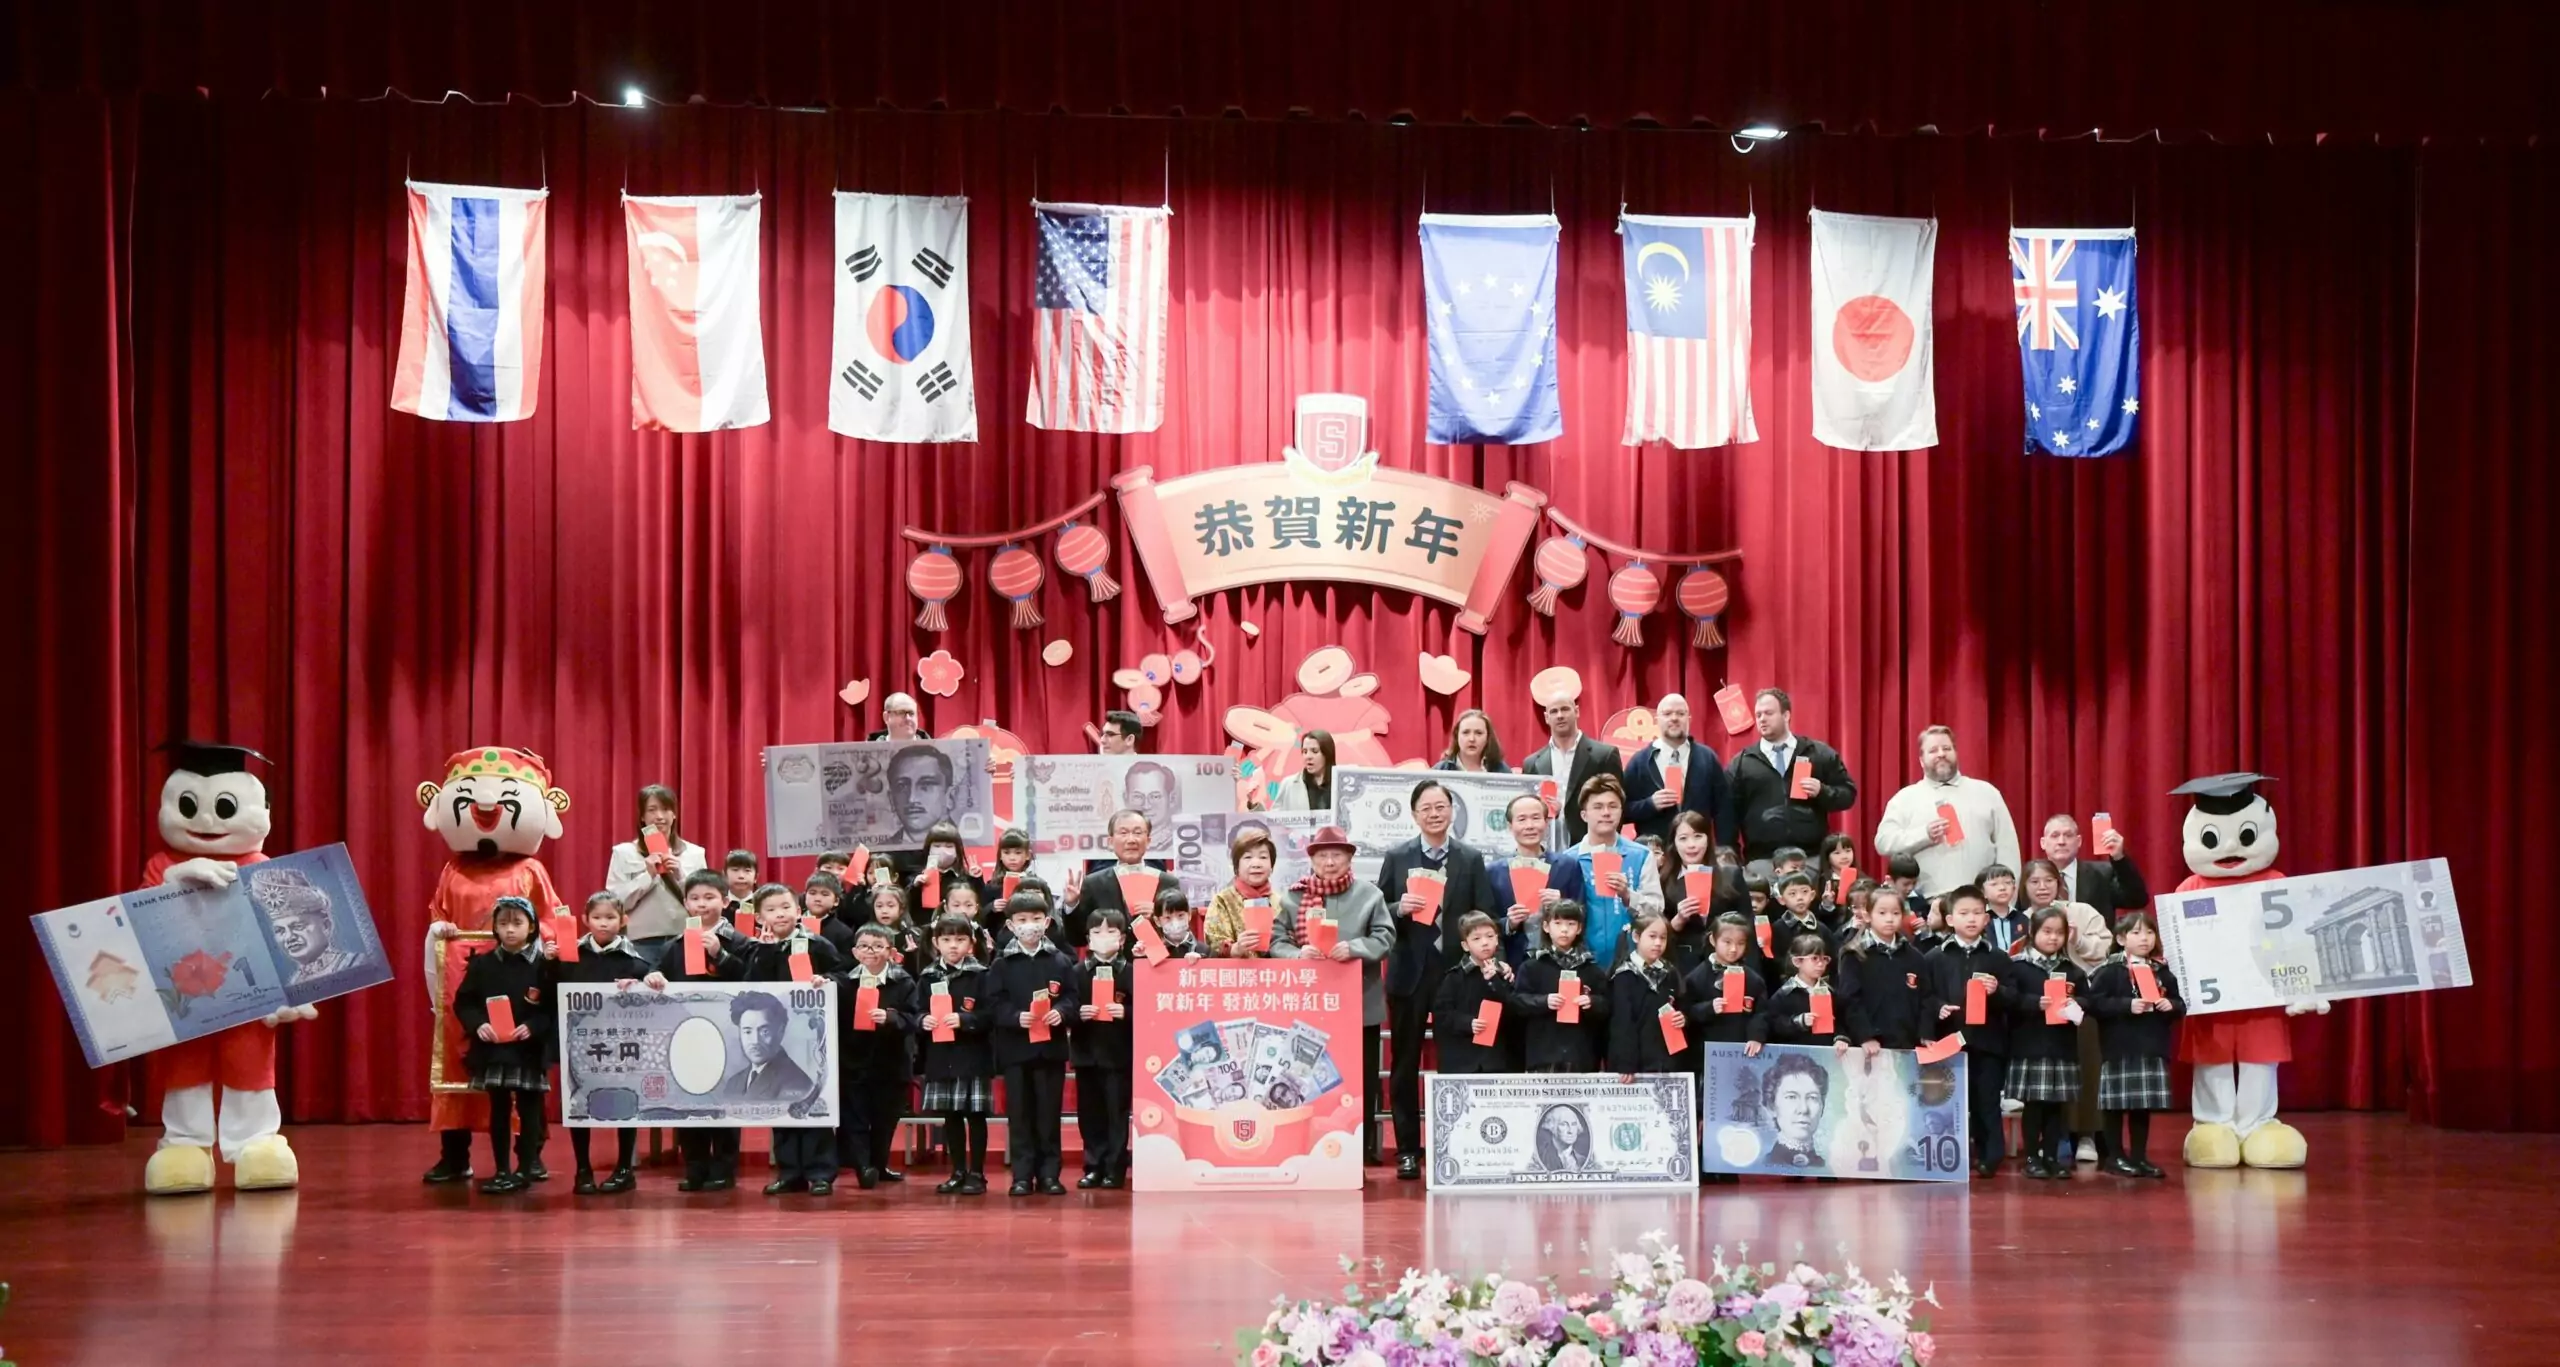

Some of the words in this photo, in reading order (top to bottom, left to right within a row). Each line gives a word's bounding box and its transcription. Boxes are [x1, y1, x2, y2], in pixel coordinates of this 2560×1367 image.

[1317, 418, 1347, 461] S
[1194, 494, 1465, 565] 恭賀新年
[1196, 763, 1224, 776] 100
[1342, 775, 1356, 793] 2
[1176, 824, 1202, 871] 100
[132, 897, 157, 909] BANK
[159, 888, 196, 903] NEGARA
[2260, 888, 2294, 931] 5
[232, 956, 257, 987] 1
[1178, 968, 1318, 988] 新興國際中小學
[2270, 965, 2308, 979] EURO
[566, 991, 603, 1011] 1000
[789, 989, 826, 1009] 1000
[2199, 978, 2221, 1005] 5
[1156, 992, 1215, 1012] 賀新年
[1222, 992, 1341, 1012] 發放外幣紅包
[586, 1042, 640, 1062] 千円
[1218, 1061, 1238, 1075] 100
[1473, 1088, 1496, 1097] THE
[1499, 1088, 1540, 1097] UNITED
[1542, 1088, 1582, 1097] STATES
[1584, 1088, 1598, 1096] OF
[1600, 1087, 1650, 1096] AMERICA
[1670, 1088, 1681, 1112] 1
[1443, 1092, 1456, 1115] 1
[1239, 1122, 1250, 1138] S
[1489, 1124, 1499, 1137] B
[1917, 1135, 1961, 1173] 10
[1443, 1161, 1453, 1177] 1
[1673, 1159, 1682, 1175] 1
[1516, 1173, 1548, 1183] ONE
[1550, 1173, 1614, 1183] DOLLAR
